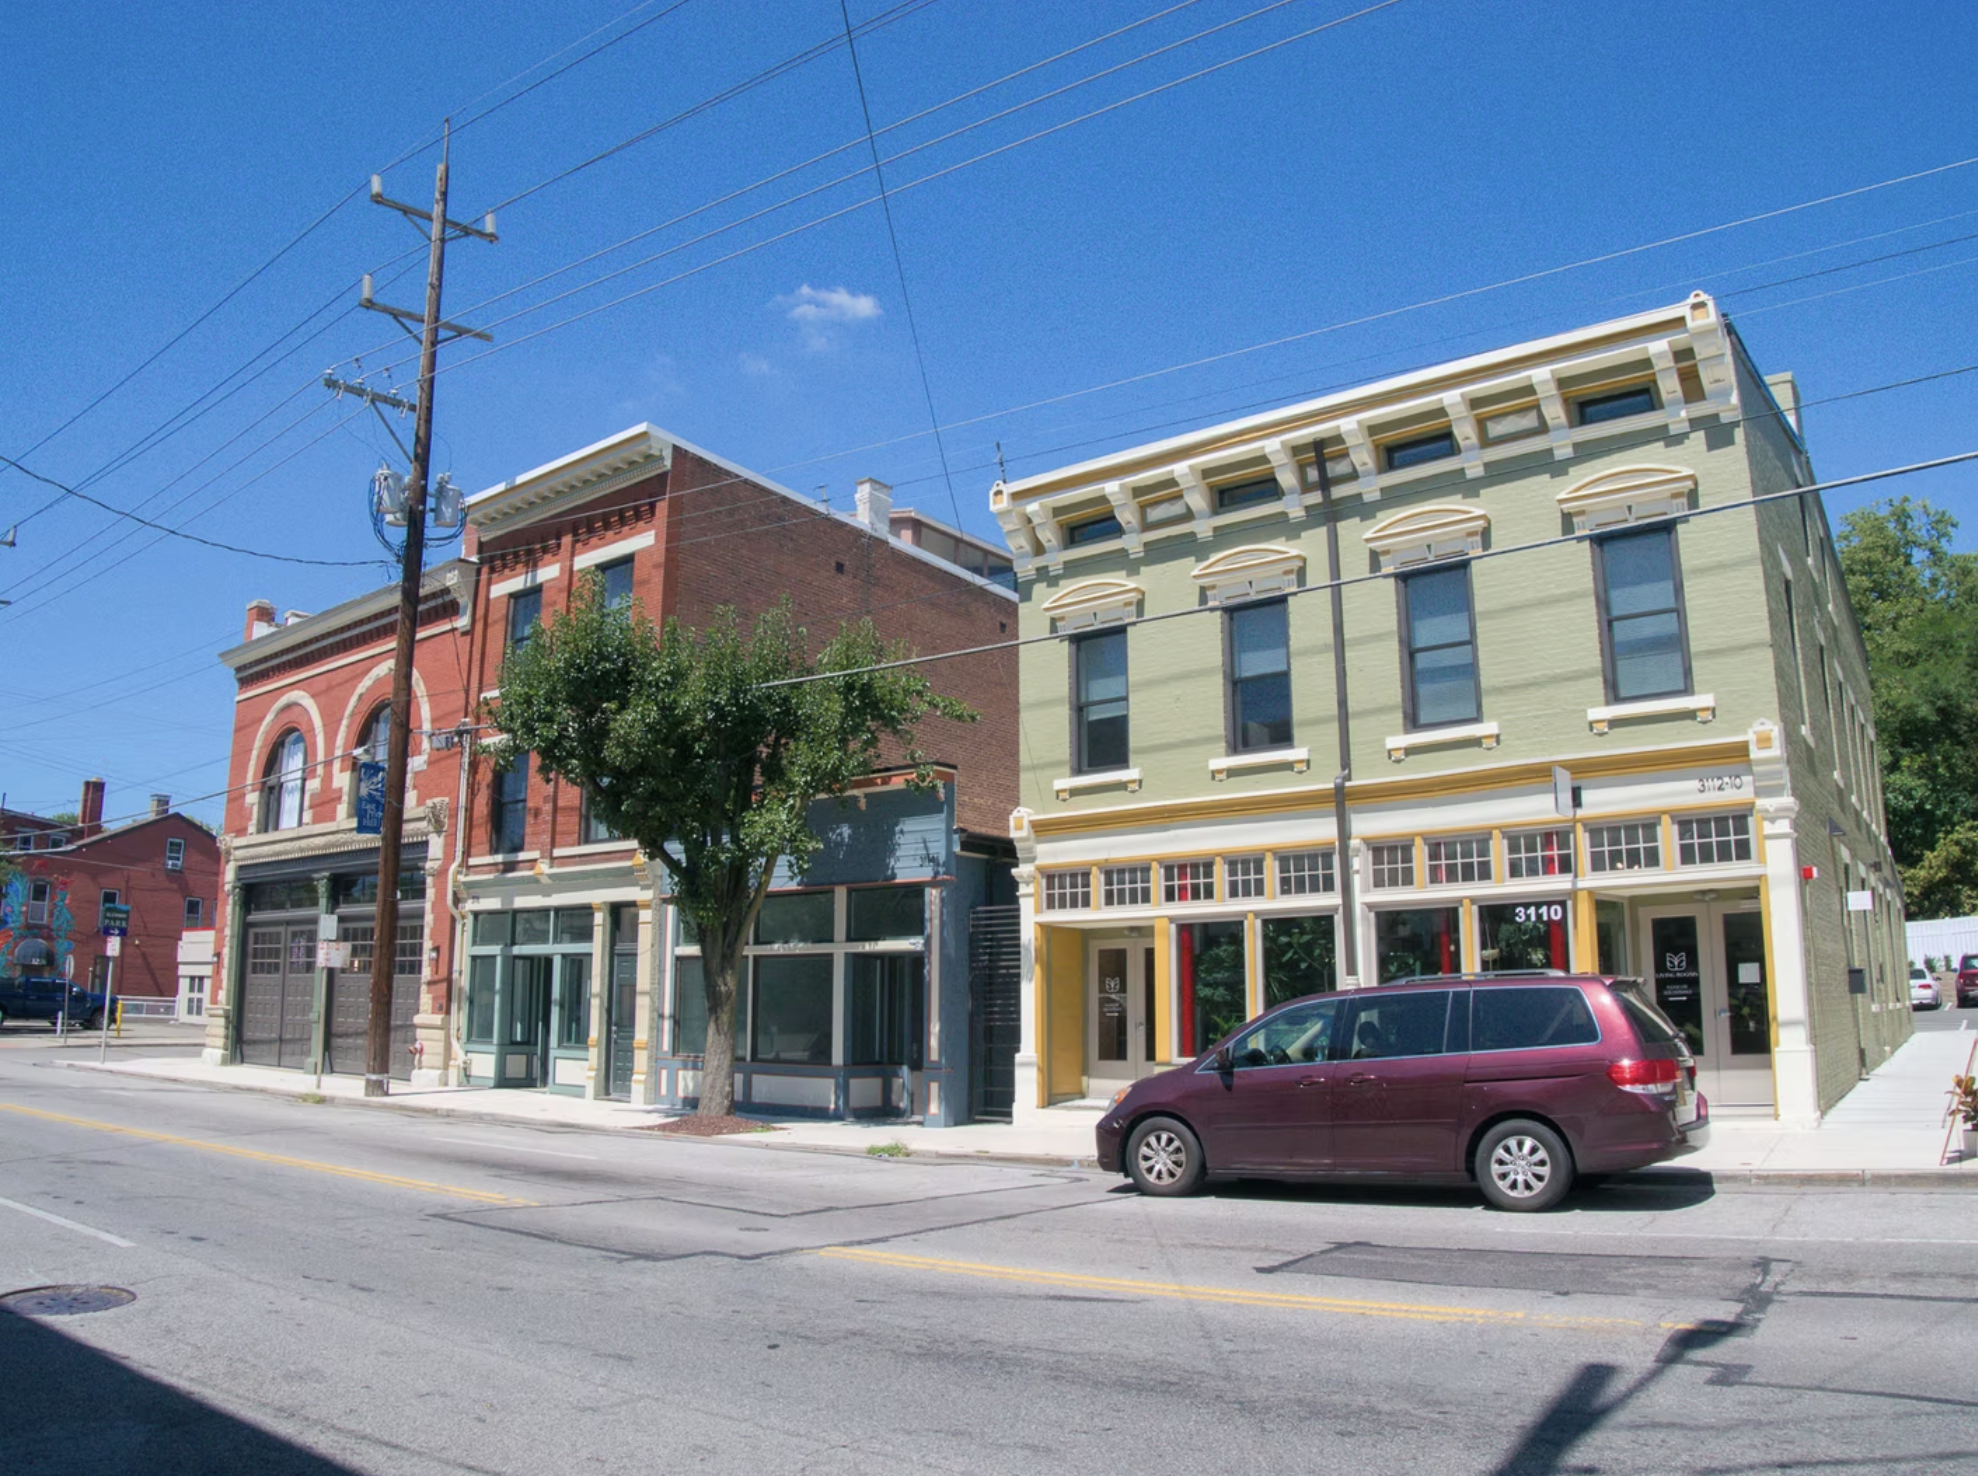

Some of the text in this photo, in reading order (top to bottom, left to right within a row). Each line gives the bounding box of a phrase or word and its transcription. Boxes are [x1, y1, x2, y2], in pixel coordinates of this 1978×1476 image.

[1697, 775, 1743, 793] 3112-10
[1515, 905, 1563, 922] 3110
[104, 918, 127, 928] PARK
